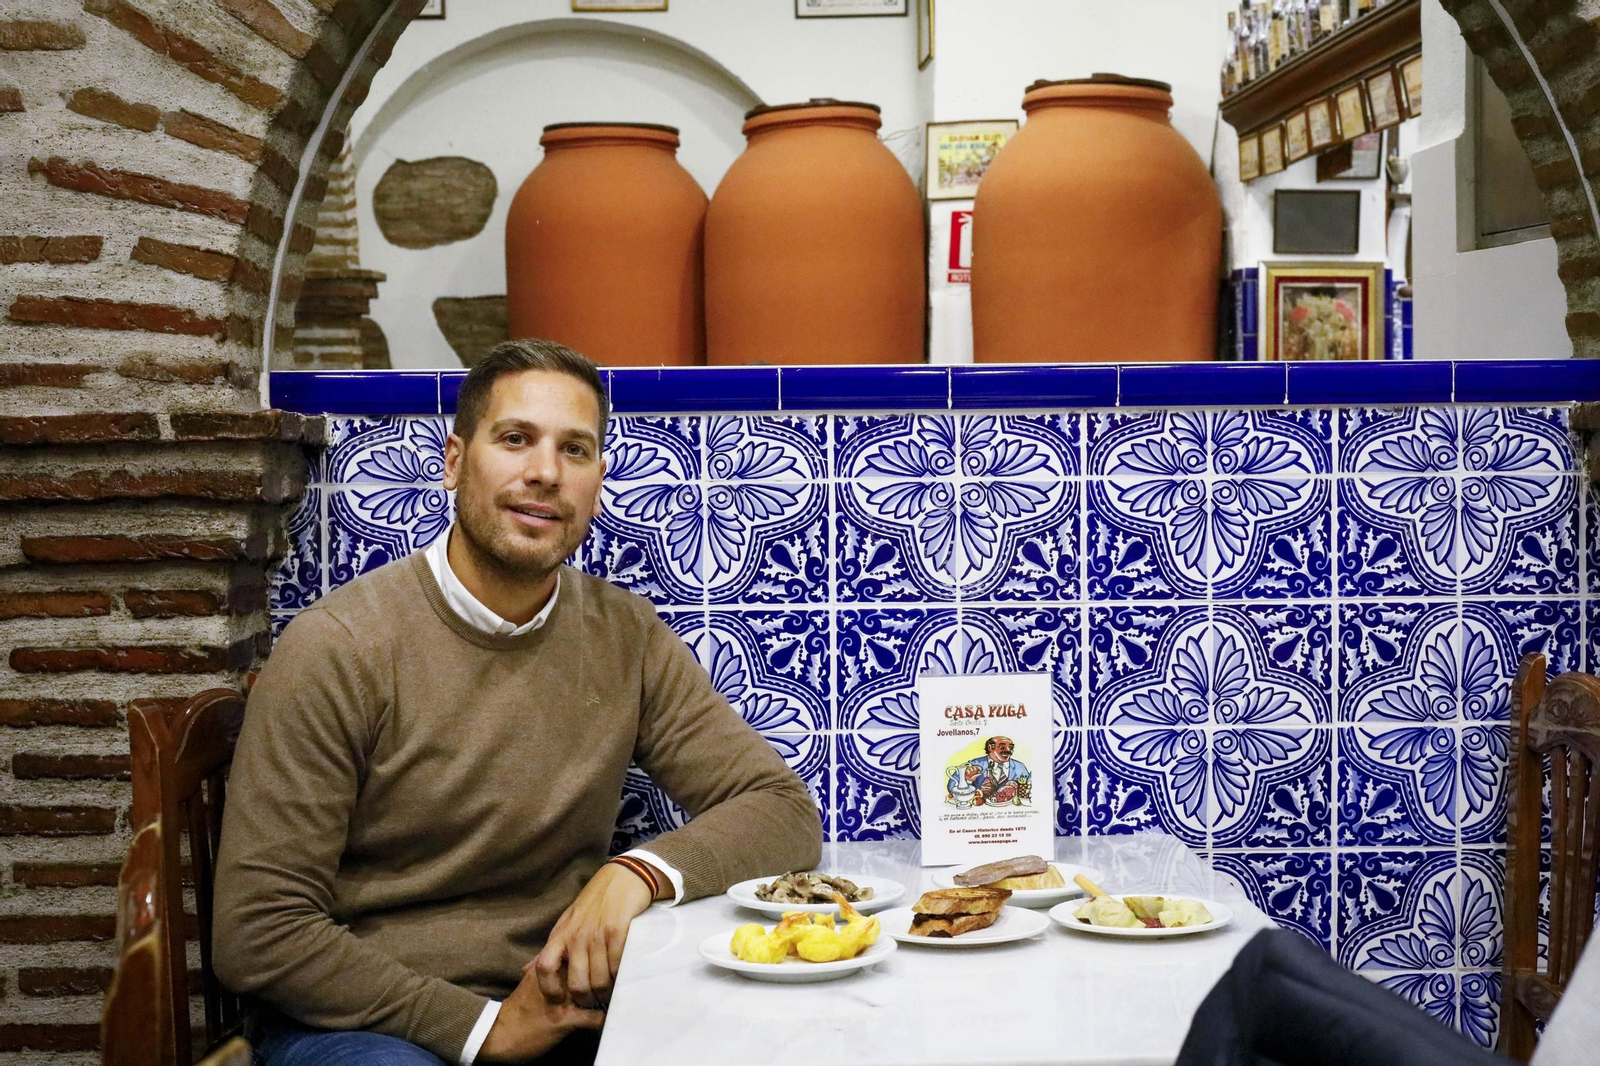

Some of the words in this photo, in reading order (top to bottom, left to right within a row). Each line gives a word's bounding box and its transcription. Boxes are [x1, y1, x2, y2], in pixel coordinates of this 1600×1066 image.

[944, 704, 986, 721] CASA
[988, 703, 1028, 719] PUGA
[936, 727, 980, 737] Jovellanos,7
